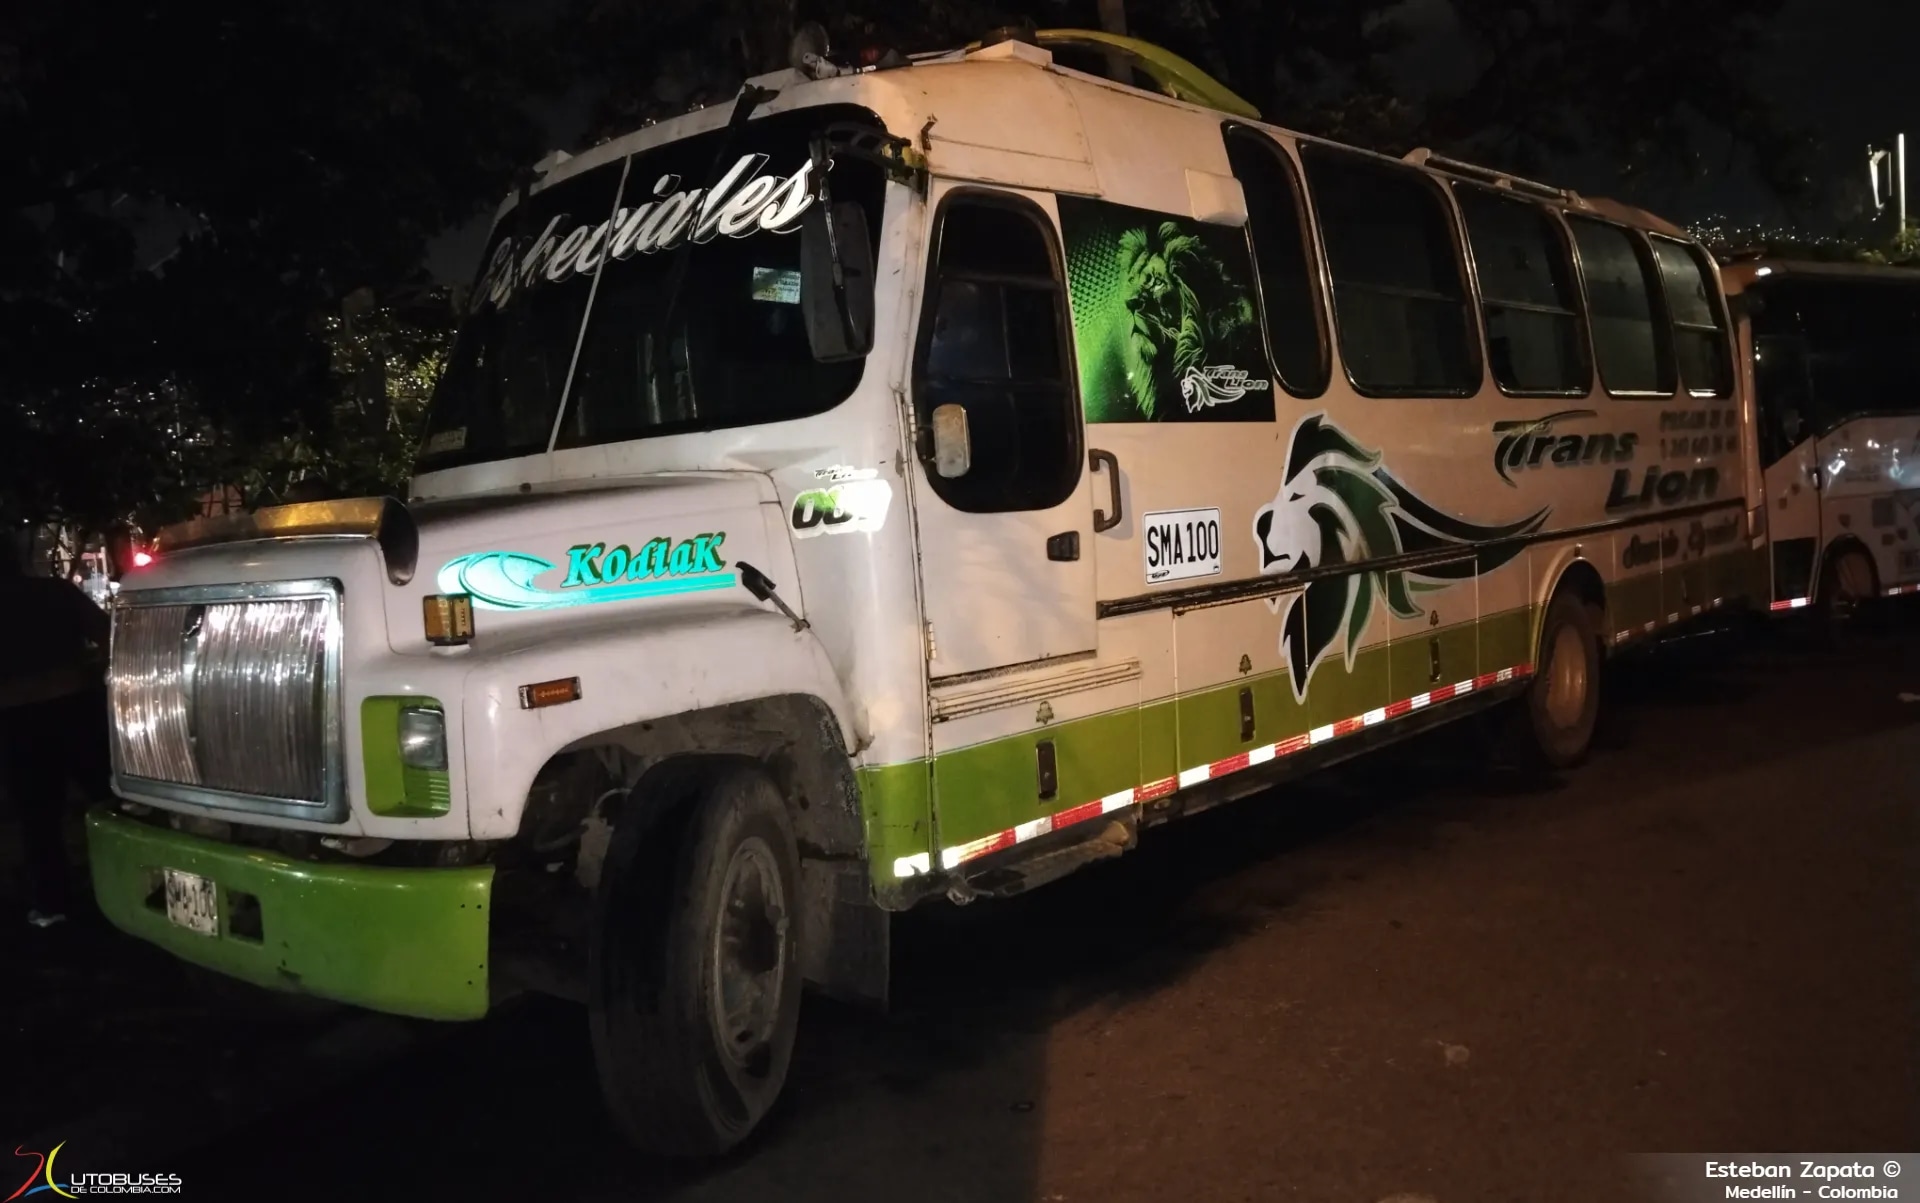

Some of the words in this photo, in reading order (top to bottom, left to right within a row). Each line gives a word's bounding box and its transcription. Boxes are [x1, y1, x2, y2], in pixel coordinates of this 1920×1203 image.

[1203, 365, 1248, 383] Trans
[1224, 379, 1269, 391] Lion
[1493, 409, 1639, 489] Trans
[1604, 464, 1720, 513] Lion
[1147, 520, 1219, 567] SMA100
